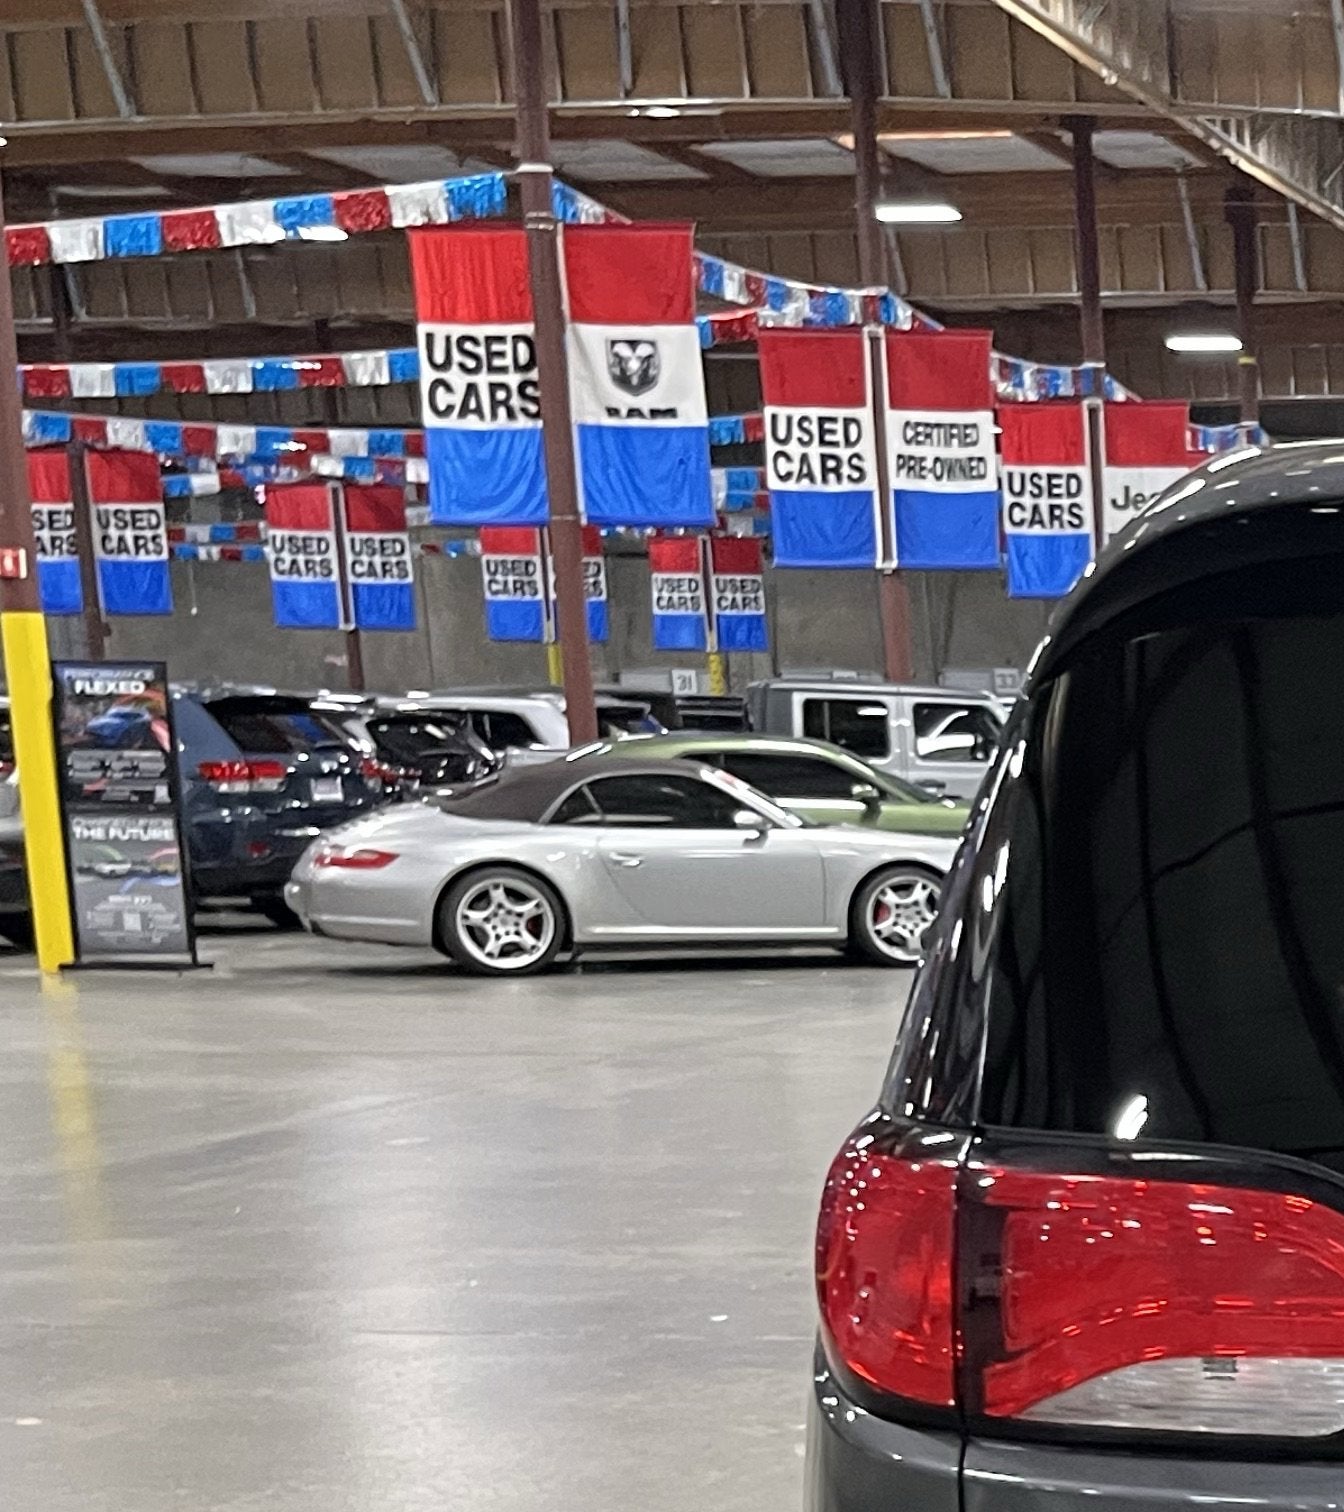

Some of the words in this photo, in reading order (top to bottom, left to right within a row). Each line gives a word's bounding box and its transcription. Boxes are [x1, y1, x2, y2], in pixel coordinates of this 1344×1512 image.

[425, 333, 537, 375] USED
[428, 378, 541, 421] CARS
[605, 407, 678, 419] RAM
[771, 413, 862, 448] USED
[902, 420, 979, 448] CERTIFIED
[772, 450, 867, 485] CARS
[896, 454, 987, 482] PRE-OWNED
[1007, 471, 1082, 499] USED
[1111, 485, 1162, 511] Je
[32, 509, 74, 531] SED
[97, 508, 161, 531] USED
[1008, 502, 1084, 529] CARS
[36, 534, 78, 556] ARS
[101, 533, 164, 556] CARS
[272, 534, 330, 555] USED
[350, 537, 405, 557] USED
[273, 557, 333, 578] CARS
[351, 560, 409, 579] CARS
[486, 559, 537, 577] USED
[487, 579, 539, 596] CARS
[656, 577, 699, 593] USED
[715, 578, 761, 594] USED
[656, 595, 701, 611] CARS
[717, 596, 762, 611] CARS
